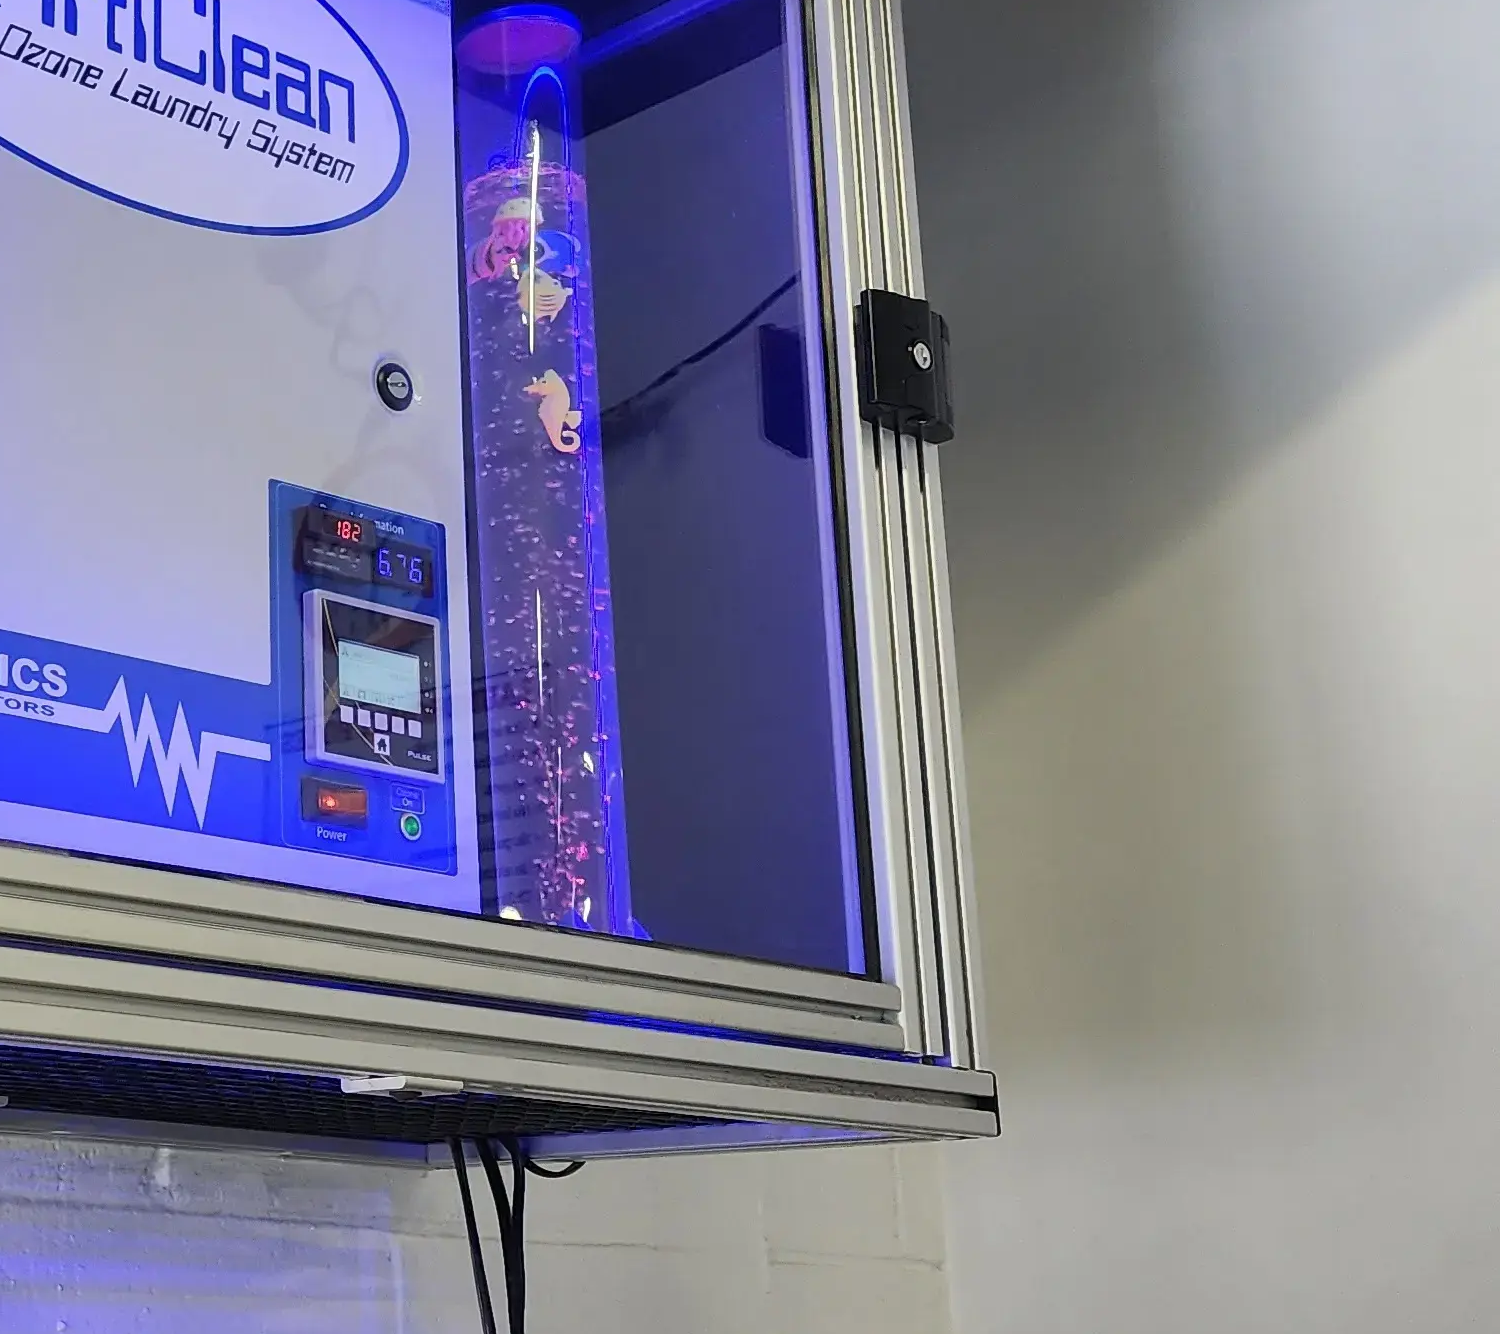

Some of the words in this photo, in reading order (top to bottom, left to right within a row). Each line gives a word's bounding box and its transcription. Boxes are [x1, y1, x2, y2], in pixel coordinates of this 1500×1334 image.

[109, 67, 241, 150] Laundry
[245, 118, 356, 184] System
[336, 520, 362, 543] 182
[316, 826, 348, 842] Power
